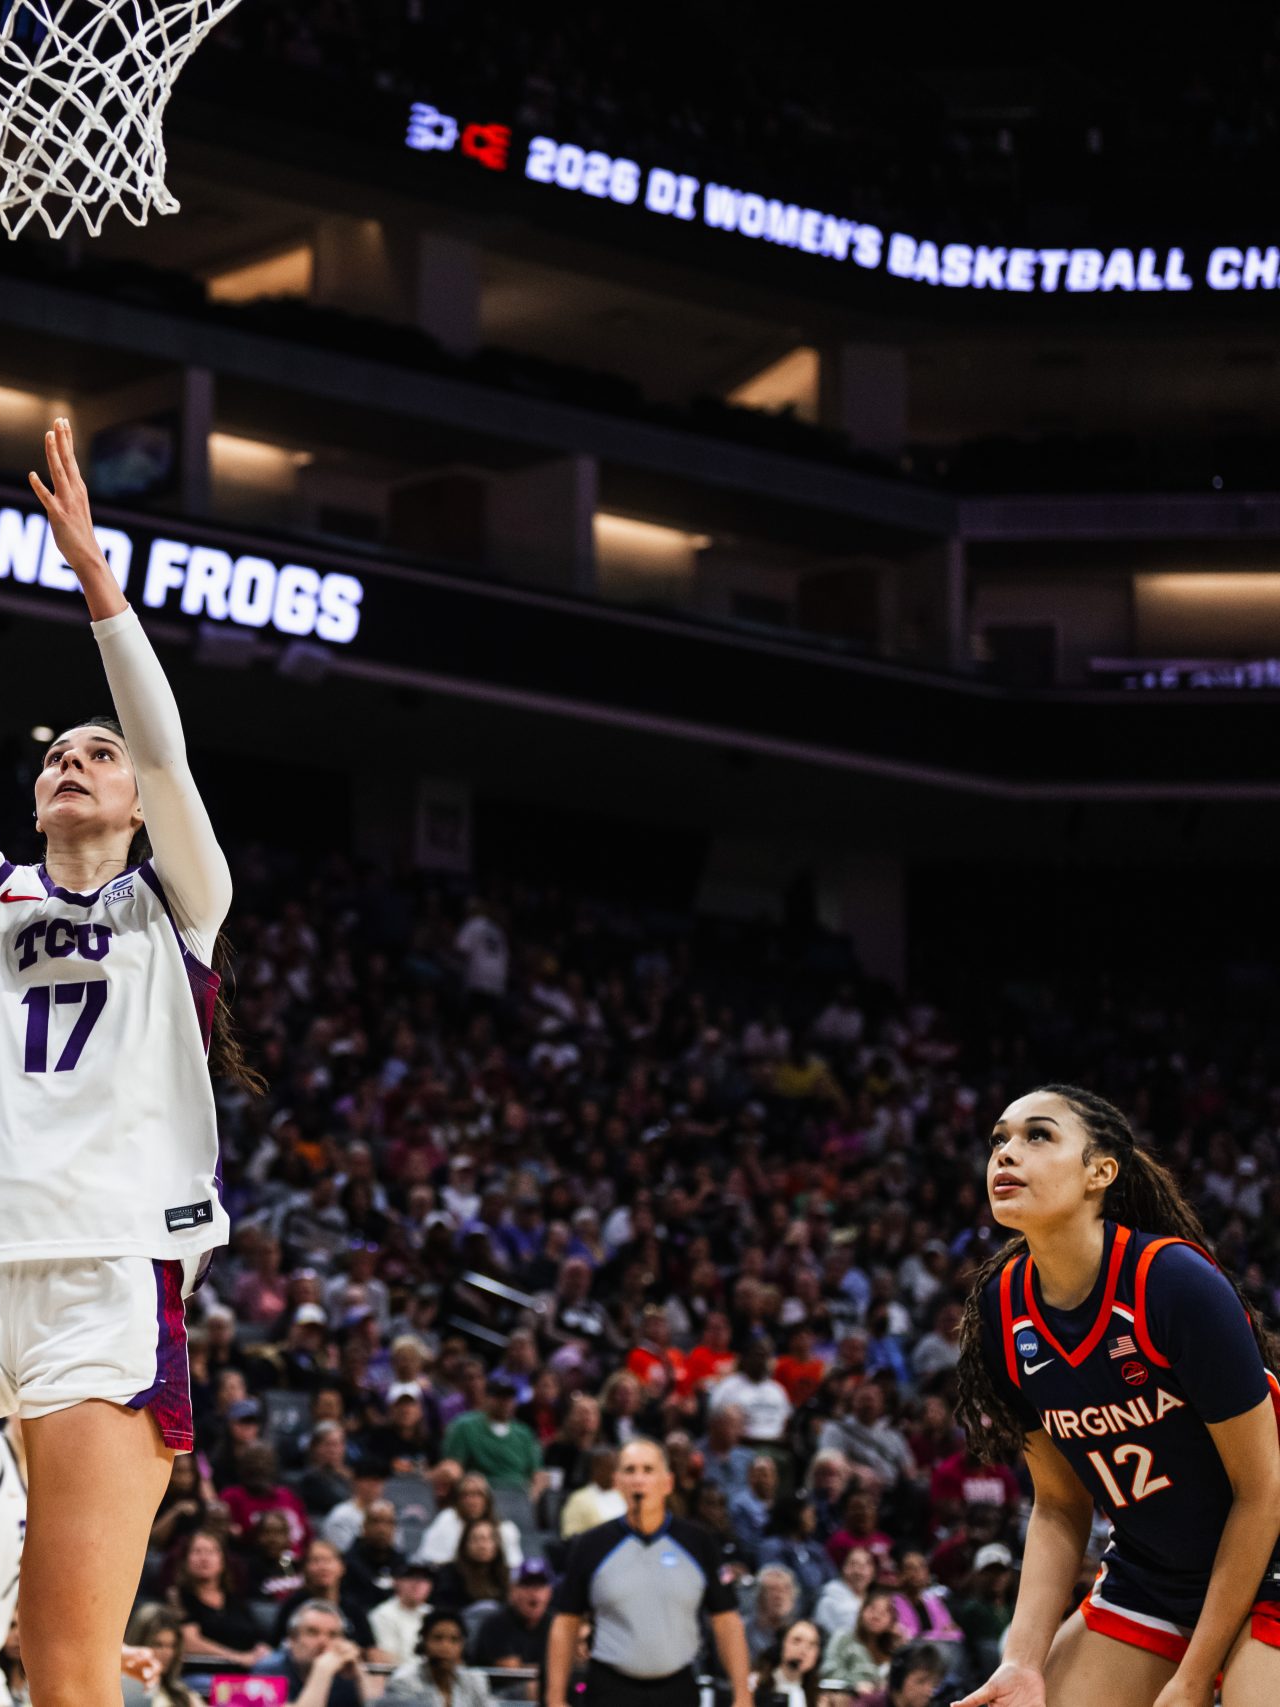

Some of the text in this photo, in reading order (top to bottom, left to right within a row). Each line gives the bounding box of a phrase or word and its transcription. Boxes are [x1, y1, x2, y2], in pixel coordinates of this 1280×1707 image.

[525, 136, 1280, 293] 2026 DI WOMEN'S BASKETBALL CH
[143, 538, 365, 644] FROGS
[14, 918, 112, 972] TCU
[21, 980, 107, 1073] 17
[197, 1208, 206, 1217] XL
[1040, 1387, 1185, 1439] VIRGINIA
[1086, 1443, 1173, 1509] 12
